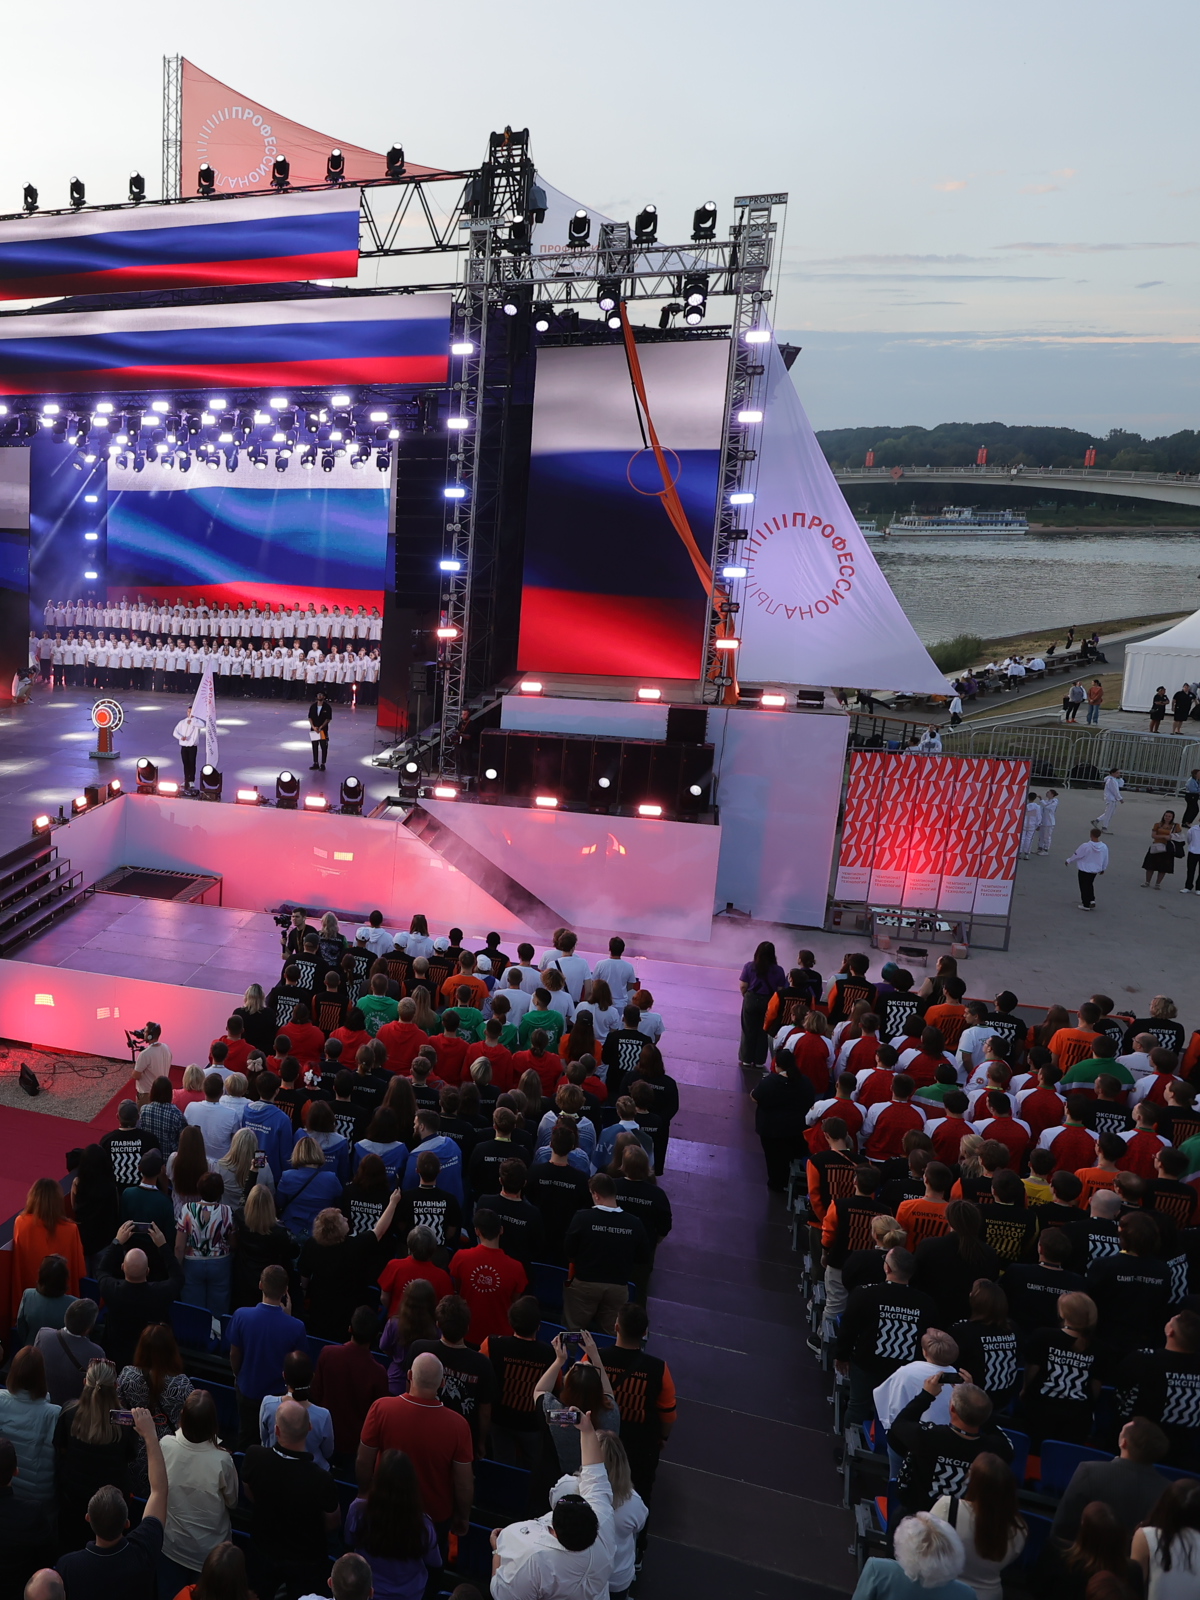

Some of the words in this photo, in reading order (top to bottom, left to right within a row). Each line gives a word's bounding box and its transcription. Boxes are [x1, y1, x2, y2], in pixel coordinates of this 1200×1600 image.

[749, 512, 855, 621] ПРОФЕССИОНАЛЫ
[887, 999, 919, 1007] ЭКСПЕРТ
[984, 1020, 1018, 1030] ЭКСПЕРТ
[1148, 1027, 1178, 1035] ЭКСПЕРТ
[334, 1113, 356, 1122] СПЕРТ
[1095, 1111, 1127, 1121] ЭКСПЕРТ
[110, 1138, 142, 1147] ГЛАВНЫЙ
[350, 1200, 383, 1210] ГЛАВНЫЙ
[413, 1199, 446, 1207] ГЛАВНЫЙ
[616, 1194, 653, 1206] АНКТ-ПЕТЕРБУРГ
[350, 1206, 382, 1215] ЭКСПЕРТ
[985, 1218, 1027, 1229] КОНКУРСАНТ
[591, 1224, 633, 1235] САНКТ-ПЕТЕРБУРГ
[986, 1227, 1025, 1239] ЮНИОР
[1088, 1233, 1120, 1243] ЭКСПЕ
[879, 1304, 921, 1316] ГЛАВНЫЙ
[879, 1311, 920, 1323] ЭКСПЕРТ
[980, 1332, 1016, 1343] ГЛАВНЫЙ
[982, 1341, 1017, 1351] ЭКСПЕРТ
[1048, 1346, 1095, 1362] ГЛАВНЫЙ
[503, 1356, 547, 1368] КОНКУРСАНТ
[1047, 1353, 1092, 1369] ЭКСПЕРТ
[1165, 1371, 1200, 1380] ГЛАВН
[1167, 1379, 1200, 1388] ЭКСПЕ
[937, 1455, 971, 1468] ЭКСП
